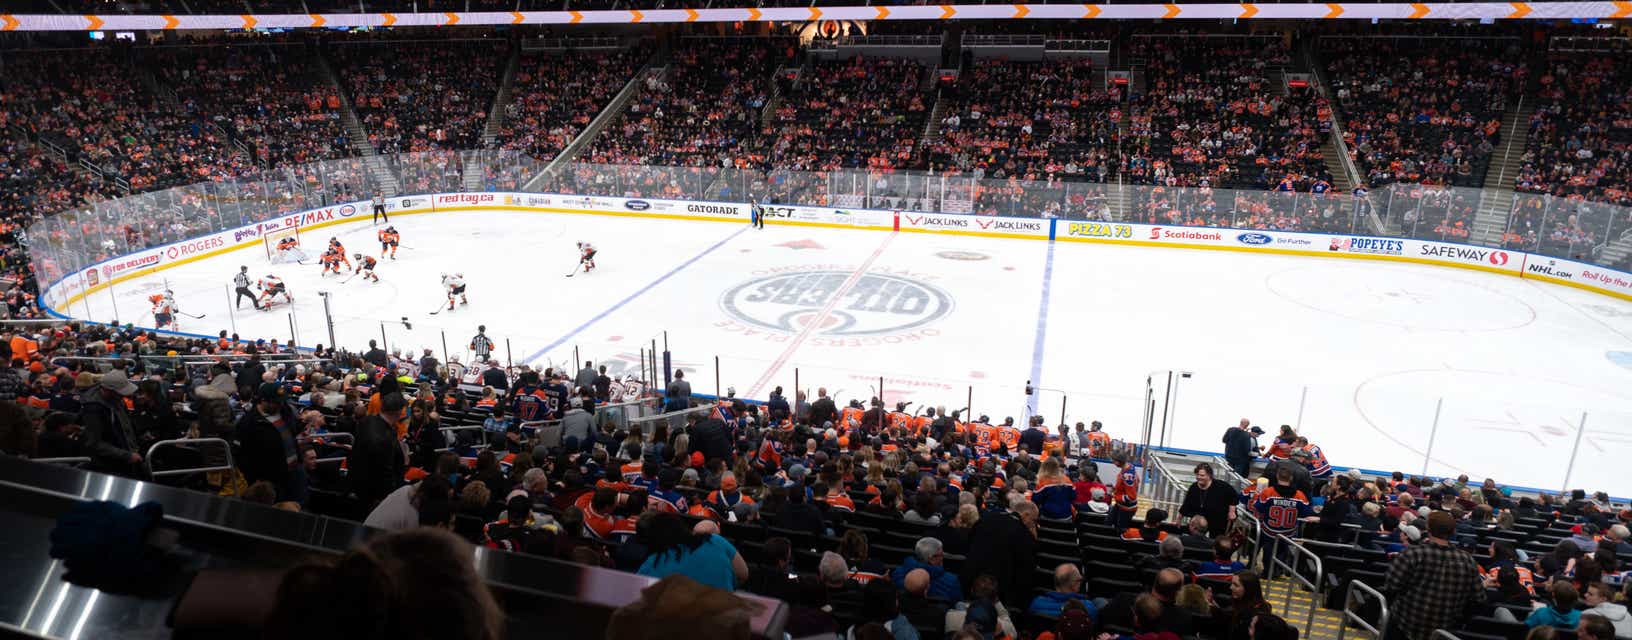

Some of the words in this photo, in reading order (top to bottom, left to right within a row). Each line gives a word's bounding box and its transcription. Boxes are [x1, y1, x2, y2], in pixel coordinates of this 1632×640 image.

[687, 204, 739, 216] GATORADE
[285, 208, 334, 228] RE/MAX
[923, 215, 944, 225] JACK
[994, 219, 1016, 230] JACK
[1069, 223, 1113, 238] PIZZA
[1114, 224, 1132, 238] 73
[1164, 230, 1222, 241] Scotiabank
[181, 236, 224, 255] ROGERS
[1243, 233, 1267, 245] Ford
[1287, 238, 1312, 246] Further
[1350, 237, 1404, 251] POPEYE'S
[1420, 244, 1488, 262] SAFEWAY
[126, 254, 160, 268] DELIVERY
[1582, 270, 1600, 280] Roll
[1600, 274, 1612, 285] Up
[1614, 277, 1628, 287] the
[746, 273, 932, 316] OILERS
[625, 384, 638, 396] 42
[520, 401, 539, 419] 17
[1268, 505, 1297, 528] 90
